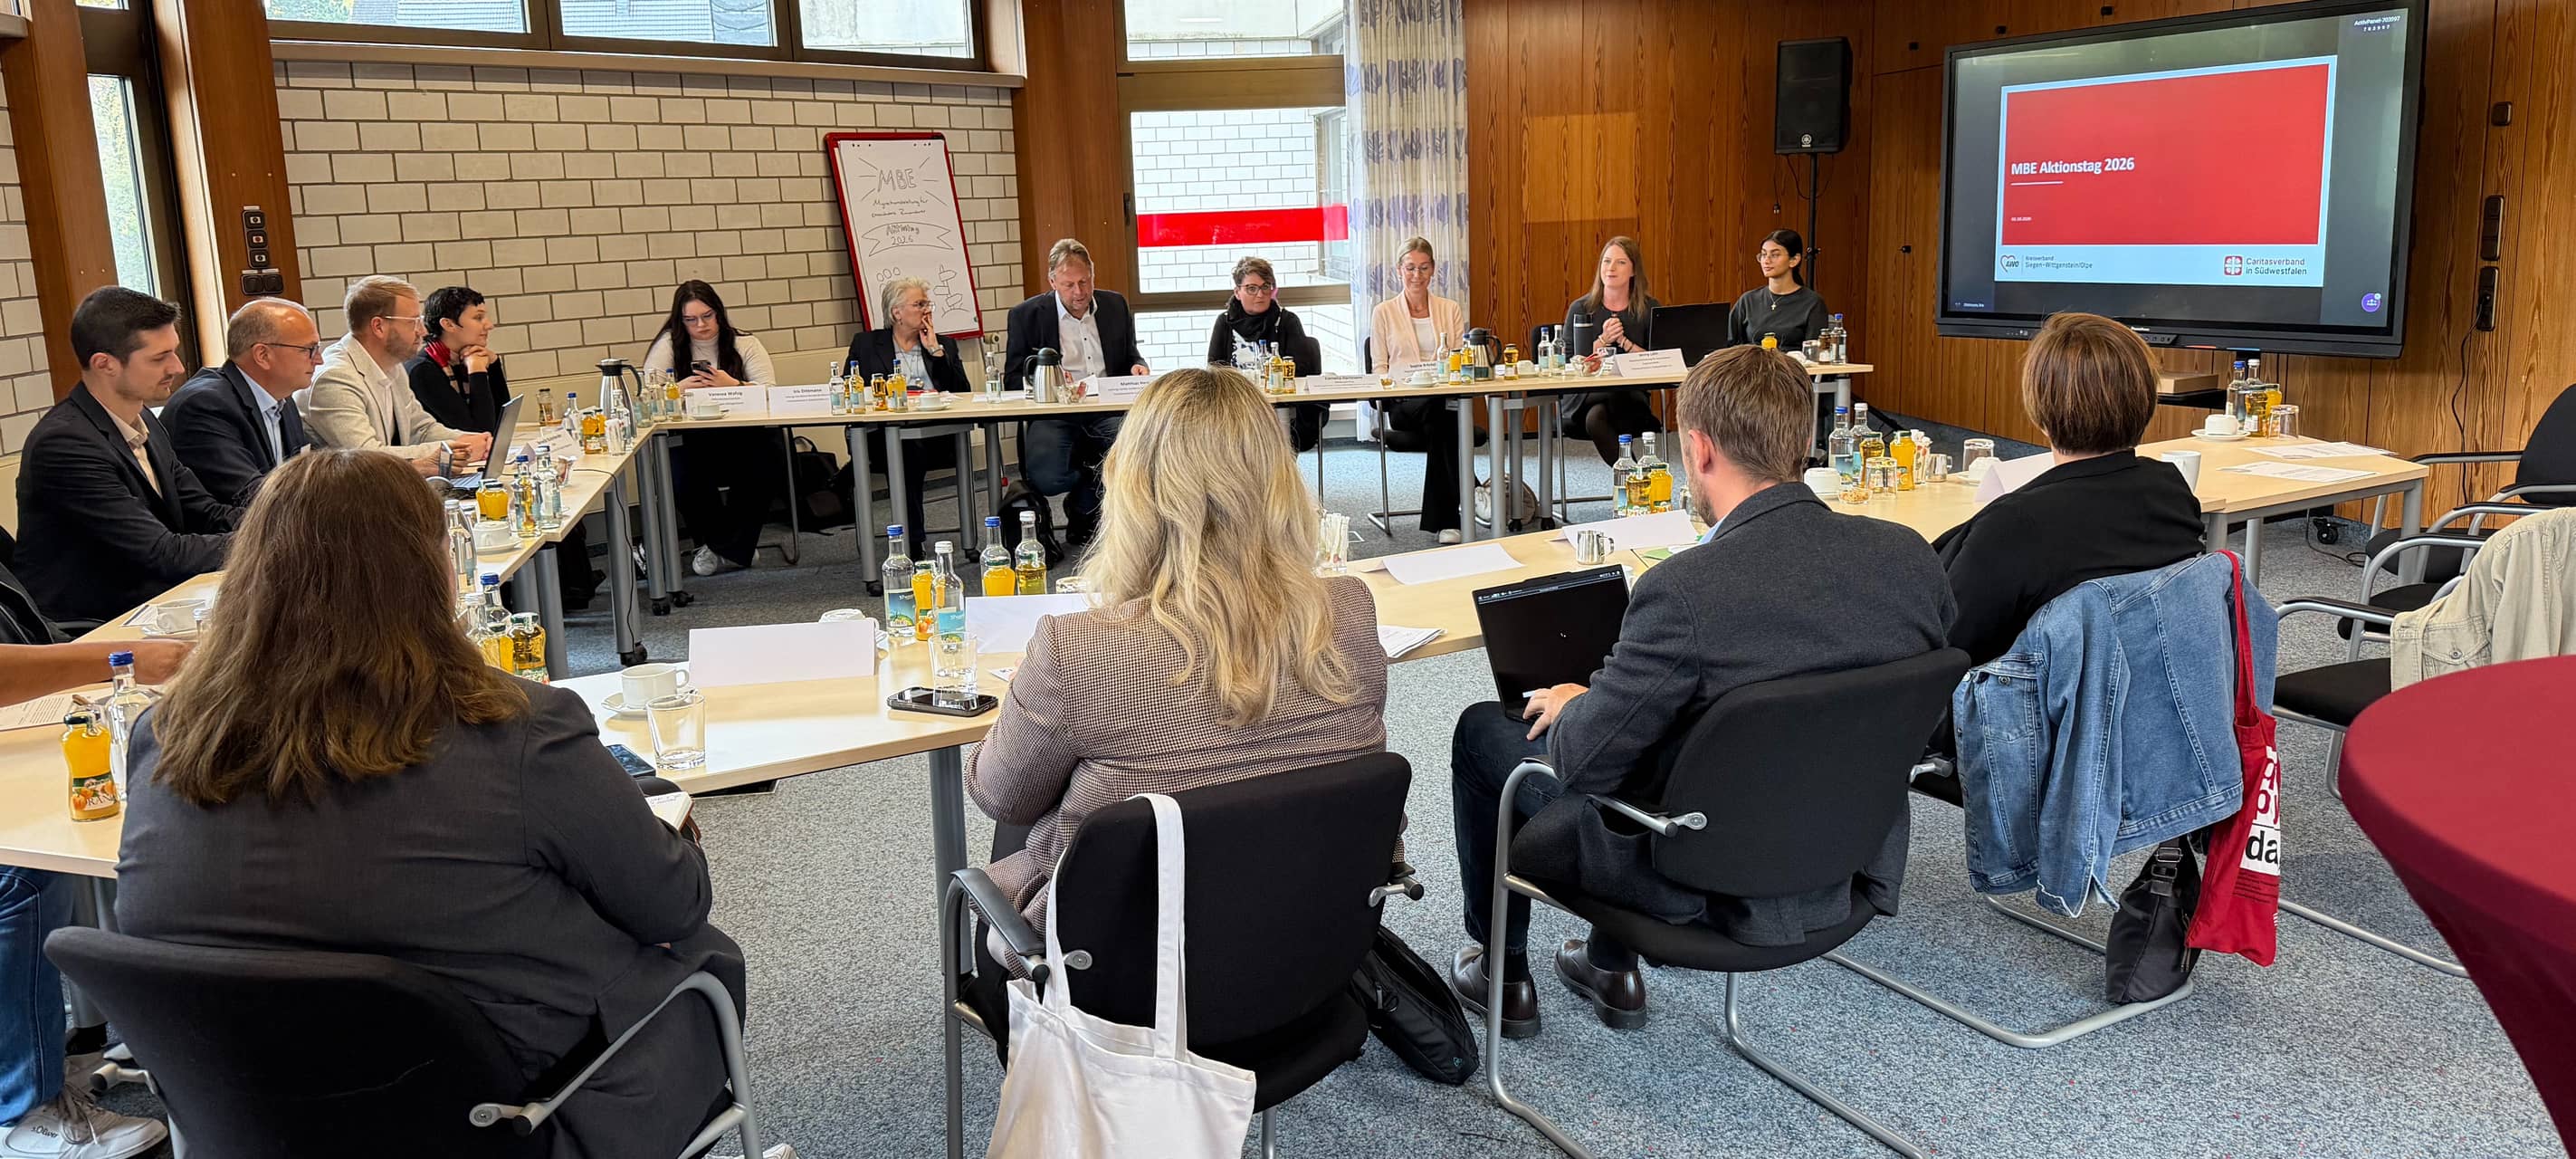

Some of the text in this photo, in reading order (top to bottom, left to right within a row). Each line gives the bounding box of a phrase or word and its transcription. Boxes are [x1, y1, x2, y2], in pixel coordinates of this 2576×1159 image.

[2011, 157, 2135, 175] MBE Aktionstag 2026
[877, 168, 917, 192] MBE
[2246, 257, 2305, 266] Caritasverband
[2246, 266, 2307, 275] in Südwestfalen
